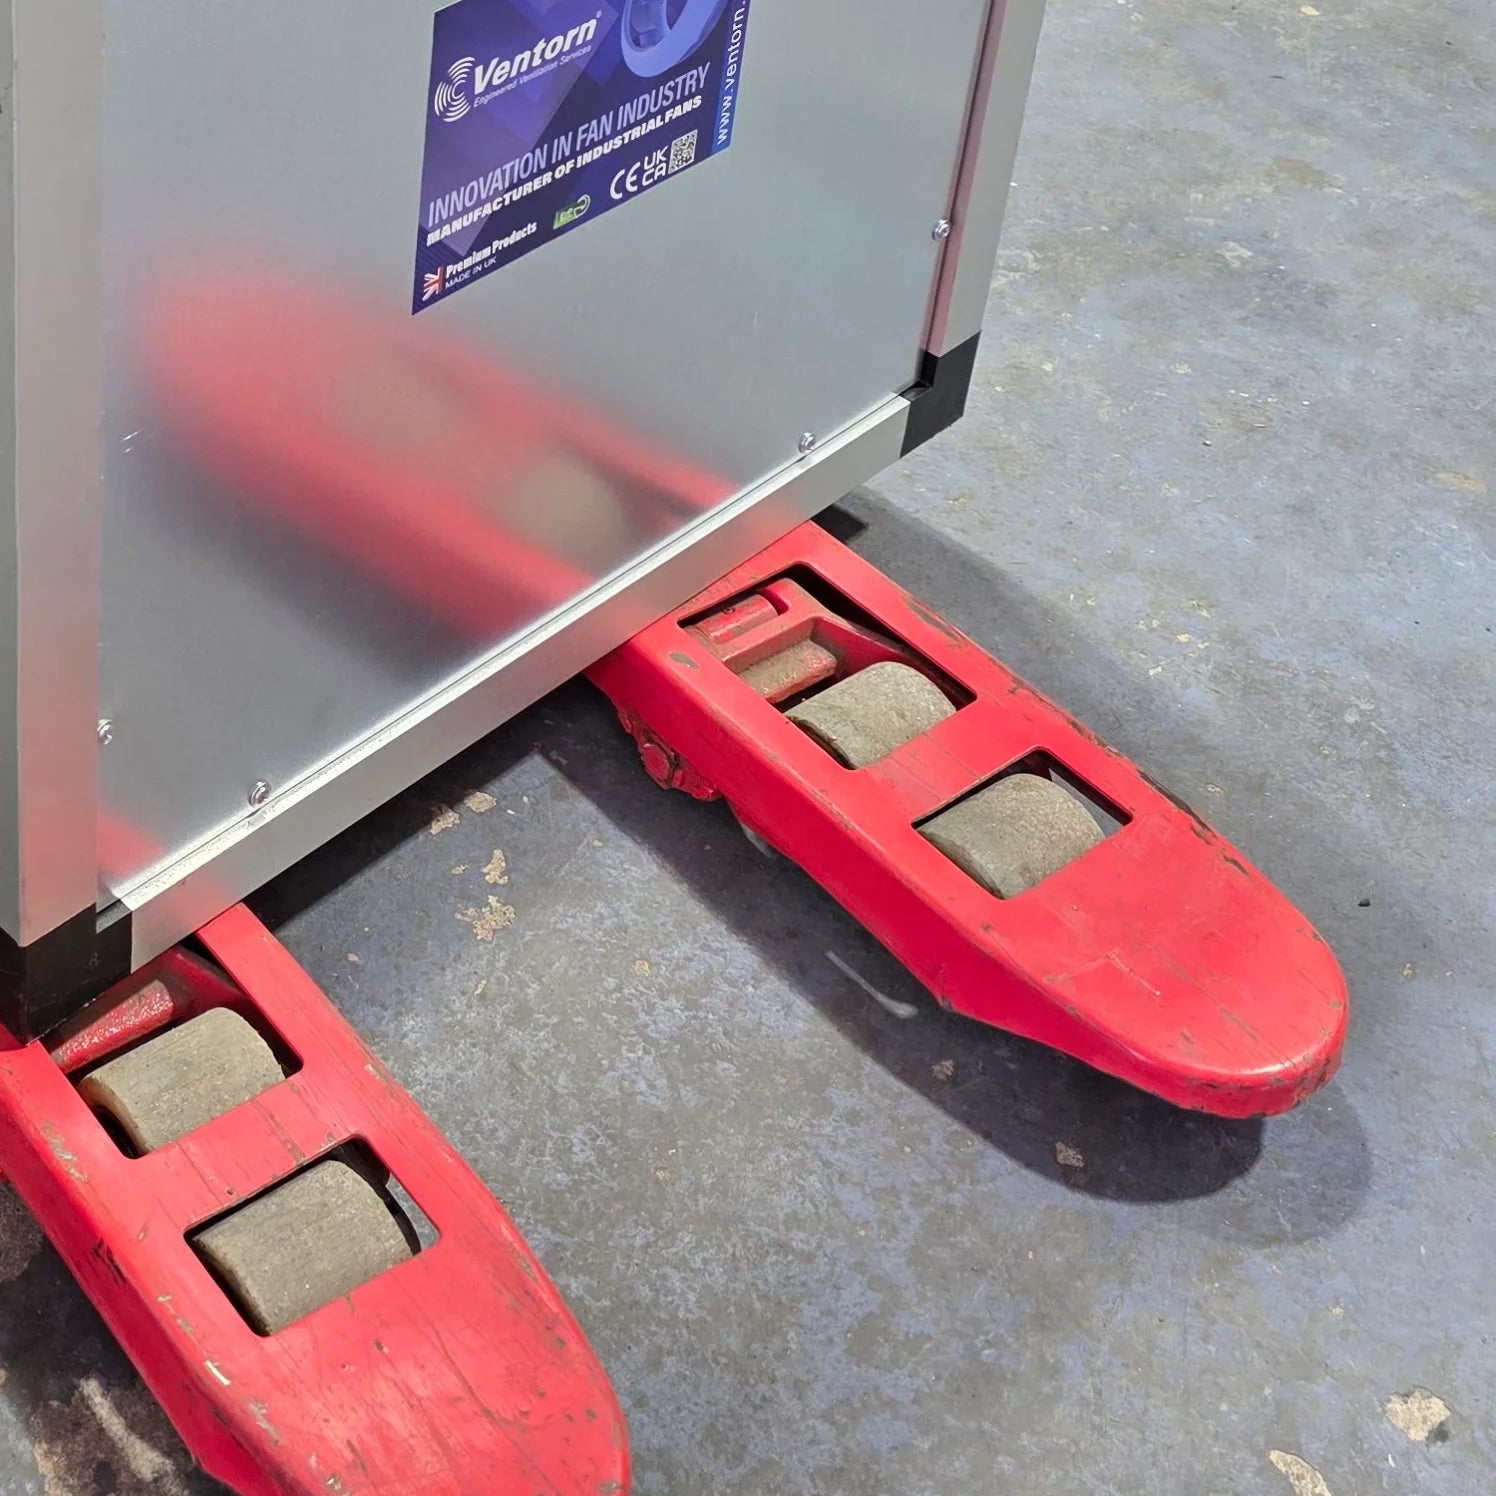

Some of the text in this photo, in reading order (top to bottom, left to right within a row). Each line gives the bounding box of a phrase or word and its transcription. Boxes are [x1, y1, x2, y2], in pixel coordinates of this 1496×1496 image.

[473, 45, 592, 107] Engineered Ventilation Services
[474, 18, 597, 95] Ventorn
[427, 171, 553, 247] MANUFACTURER
[554, 158, 575, 180] OF
[576, 118, 664, 168] INDUSTRIAL
[664, 95, 702, 123] FANS
[428, 143, 548, 228] INNOVATION
[551, 131, 573, 164] IN
[576, 111, 614, 151] FAN
[617, 61, 710, 130] INDUSTRY
[643, 145, 669, 171] UK
[609, 161, 641, 200] CE
[642, 162, 667, 187] CA
[445, 221, 538, 279] Premium Products
[445, 256, 497, 289] MADE IN UK
